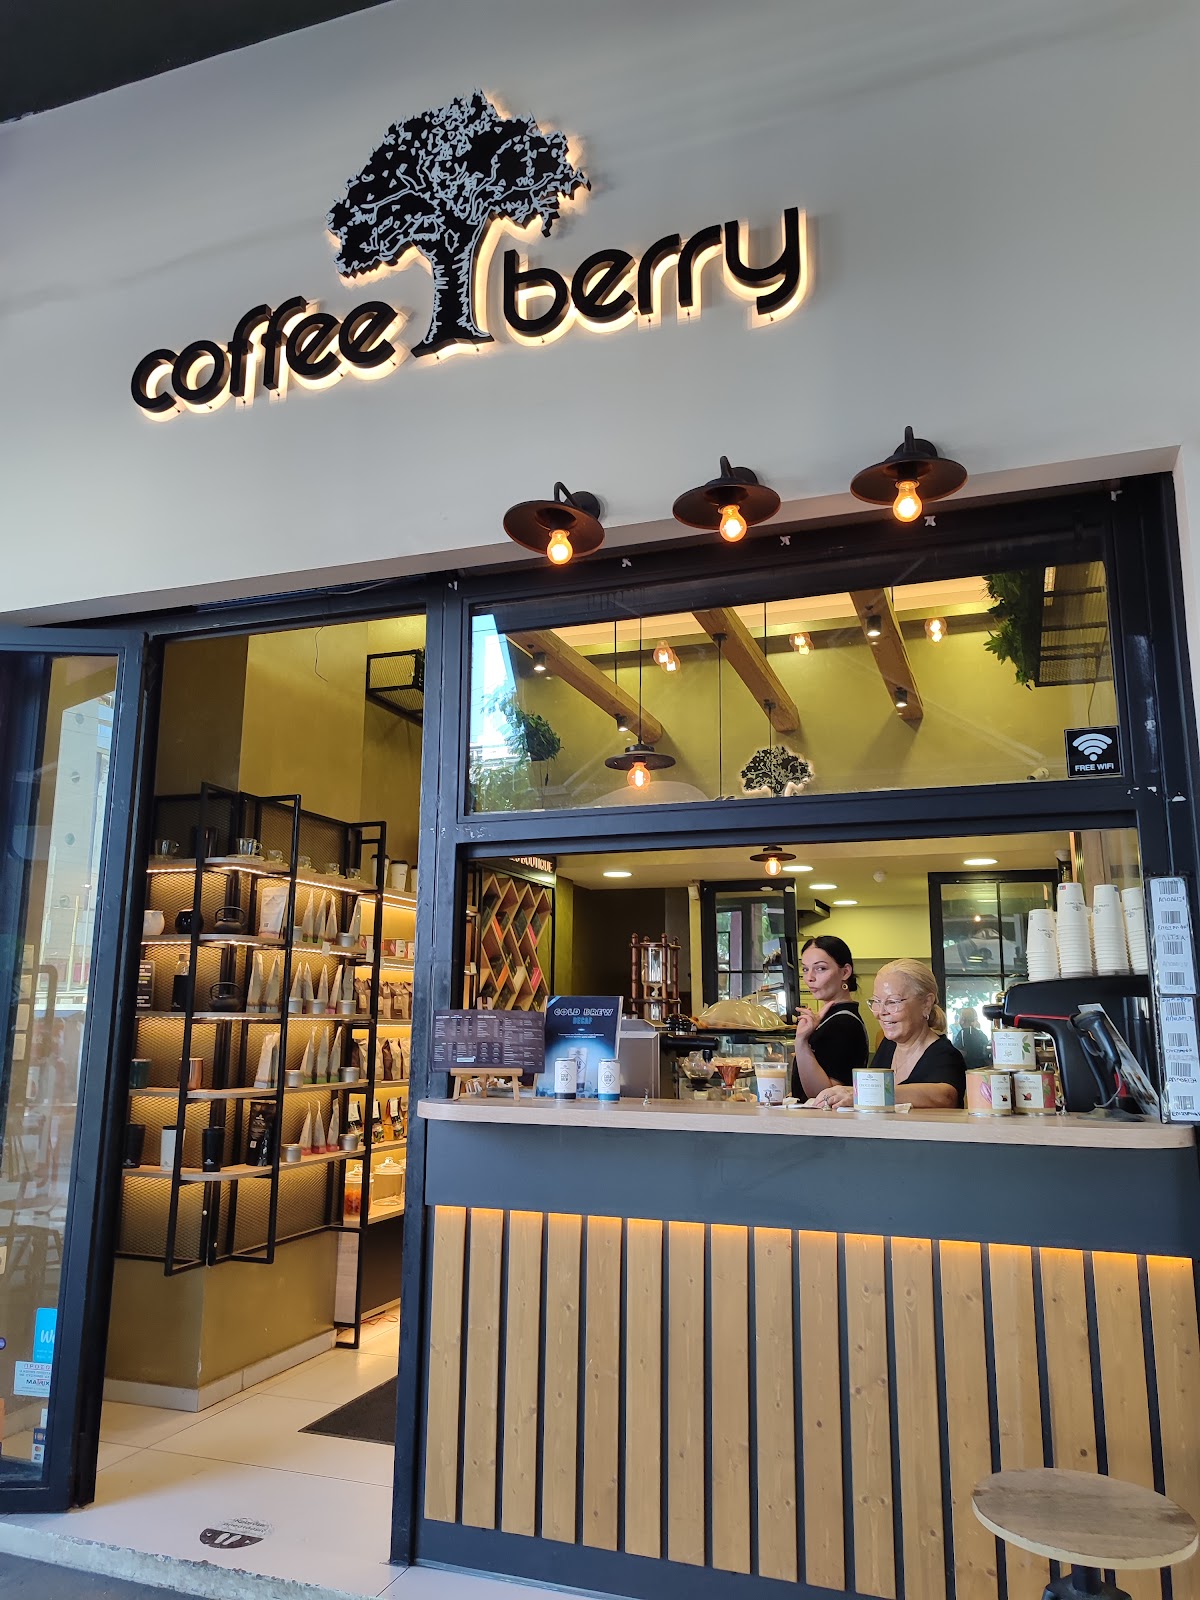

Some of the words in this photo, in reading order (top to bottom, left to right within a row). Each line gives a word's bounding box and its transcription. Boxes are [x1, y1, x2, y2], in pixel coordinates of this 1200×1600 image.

[131, 295, 399, 414] coffee
[502, 206, 800, 339] berry
[1074, 763, 1096, 772] FREE
[553, 1008, 581, 1017] COLD
[583, 1008, 614, 1017] BREW
[572, 1016, 593, 1025] DECAF
[25, 1378, 50, 1387] MATRIX
